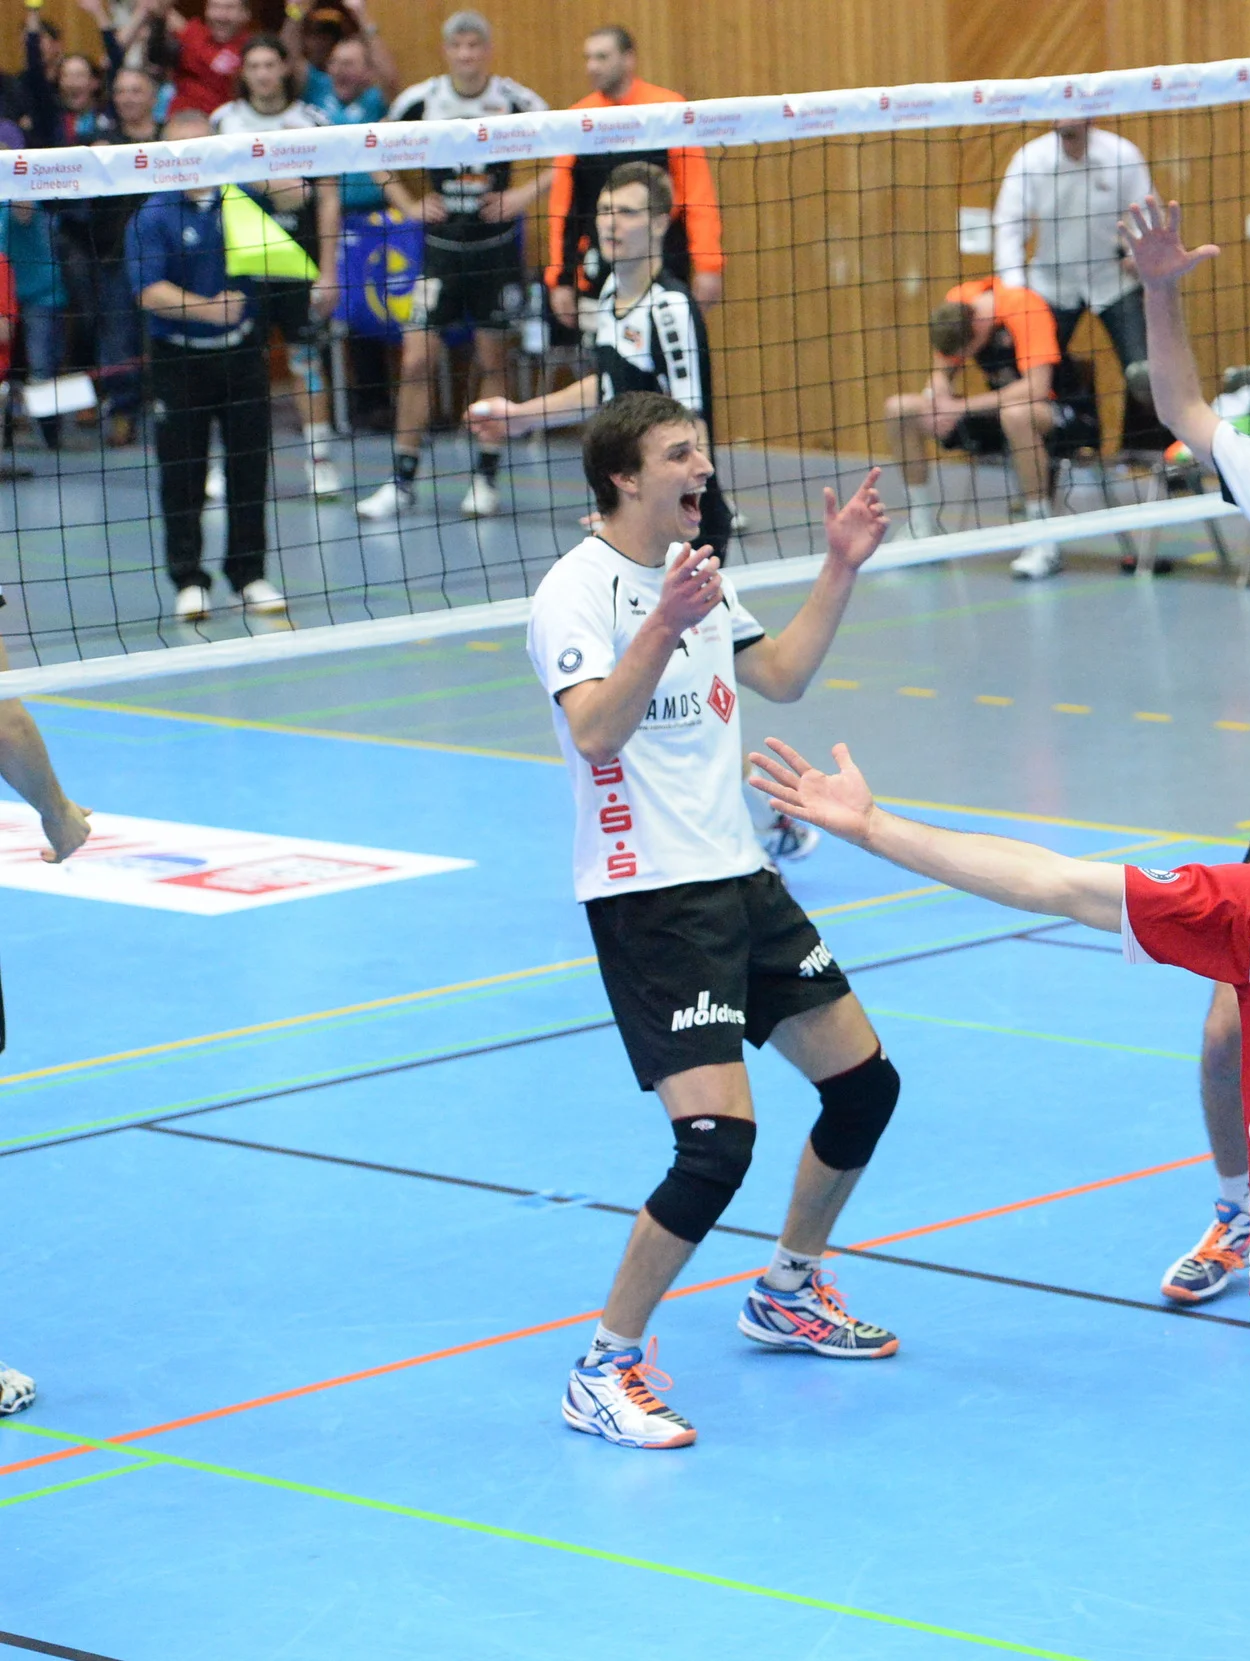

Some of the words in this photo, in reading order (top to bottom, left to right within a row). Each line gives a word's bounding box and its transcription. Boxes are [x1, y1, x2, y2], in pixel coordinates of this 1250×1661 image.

[32, 163, 83, 176] Sparkasse
[152, 170, 199, 184] Lüneburg
[30, 178, 79, 191] Lüneburg
[645, 692, 701, 720] AMOS
